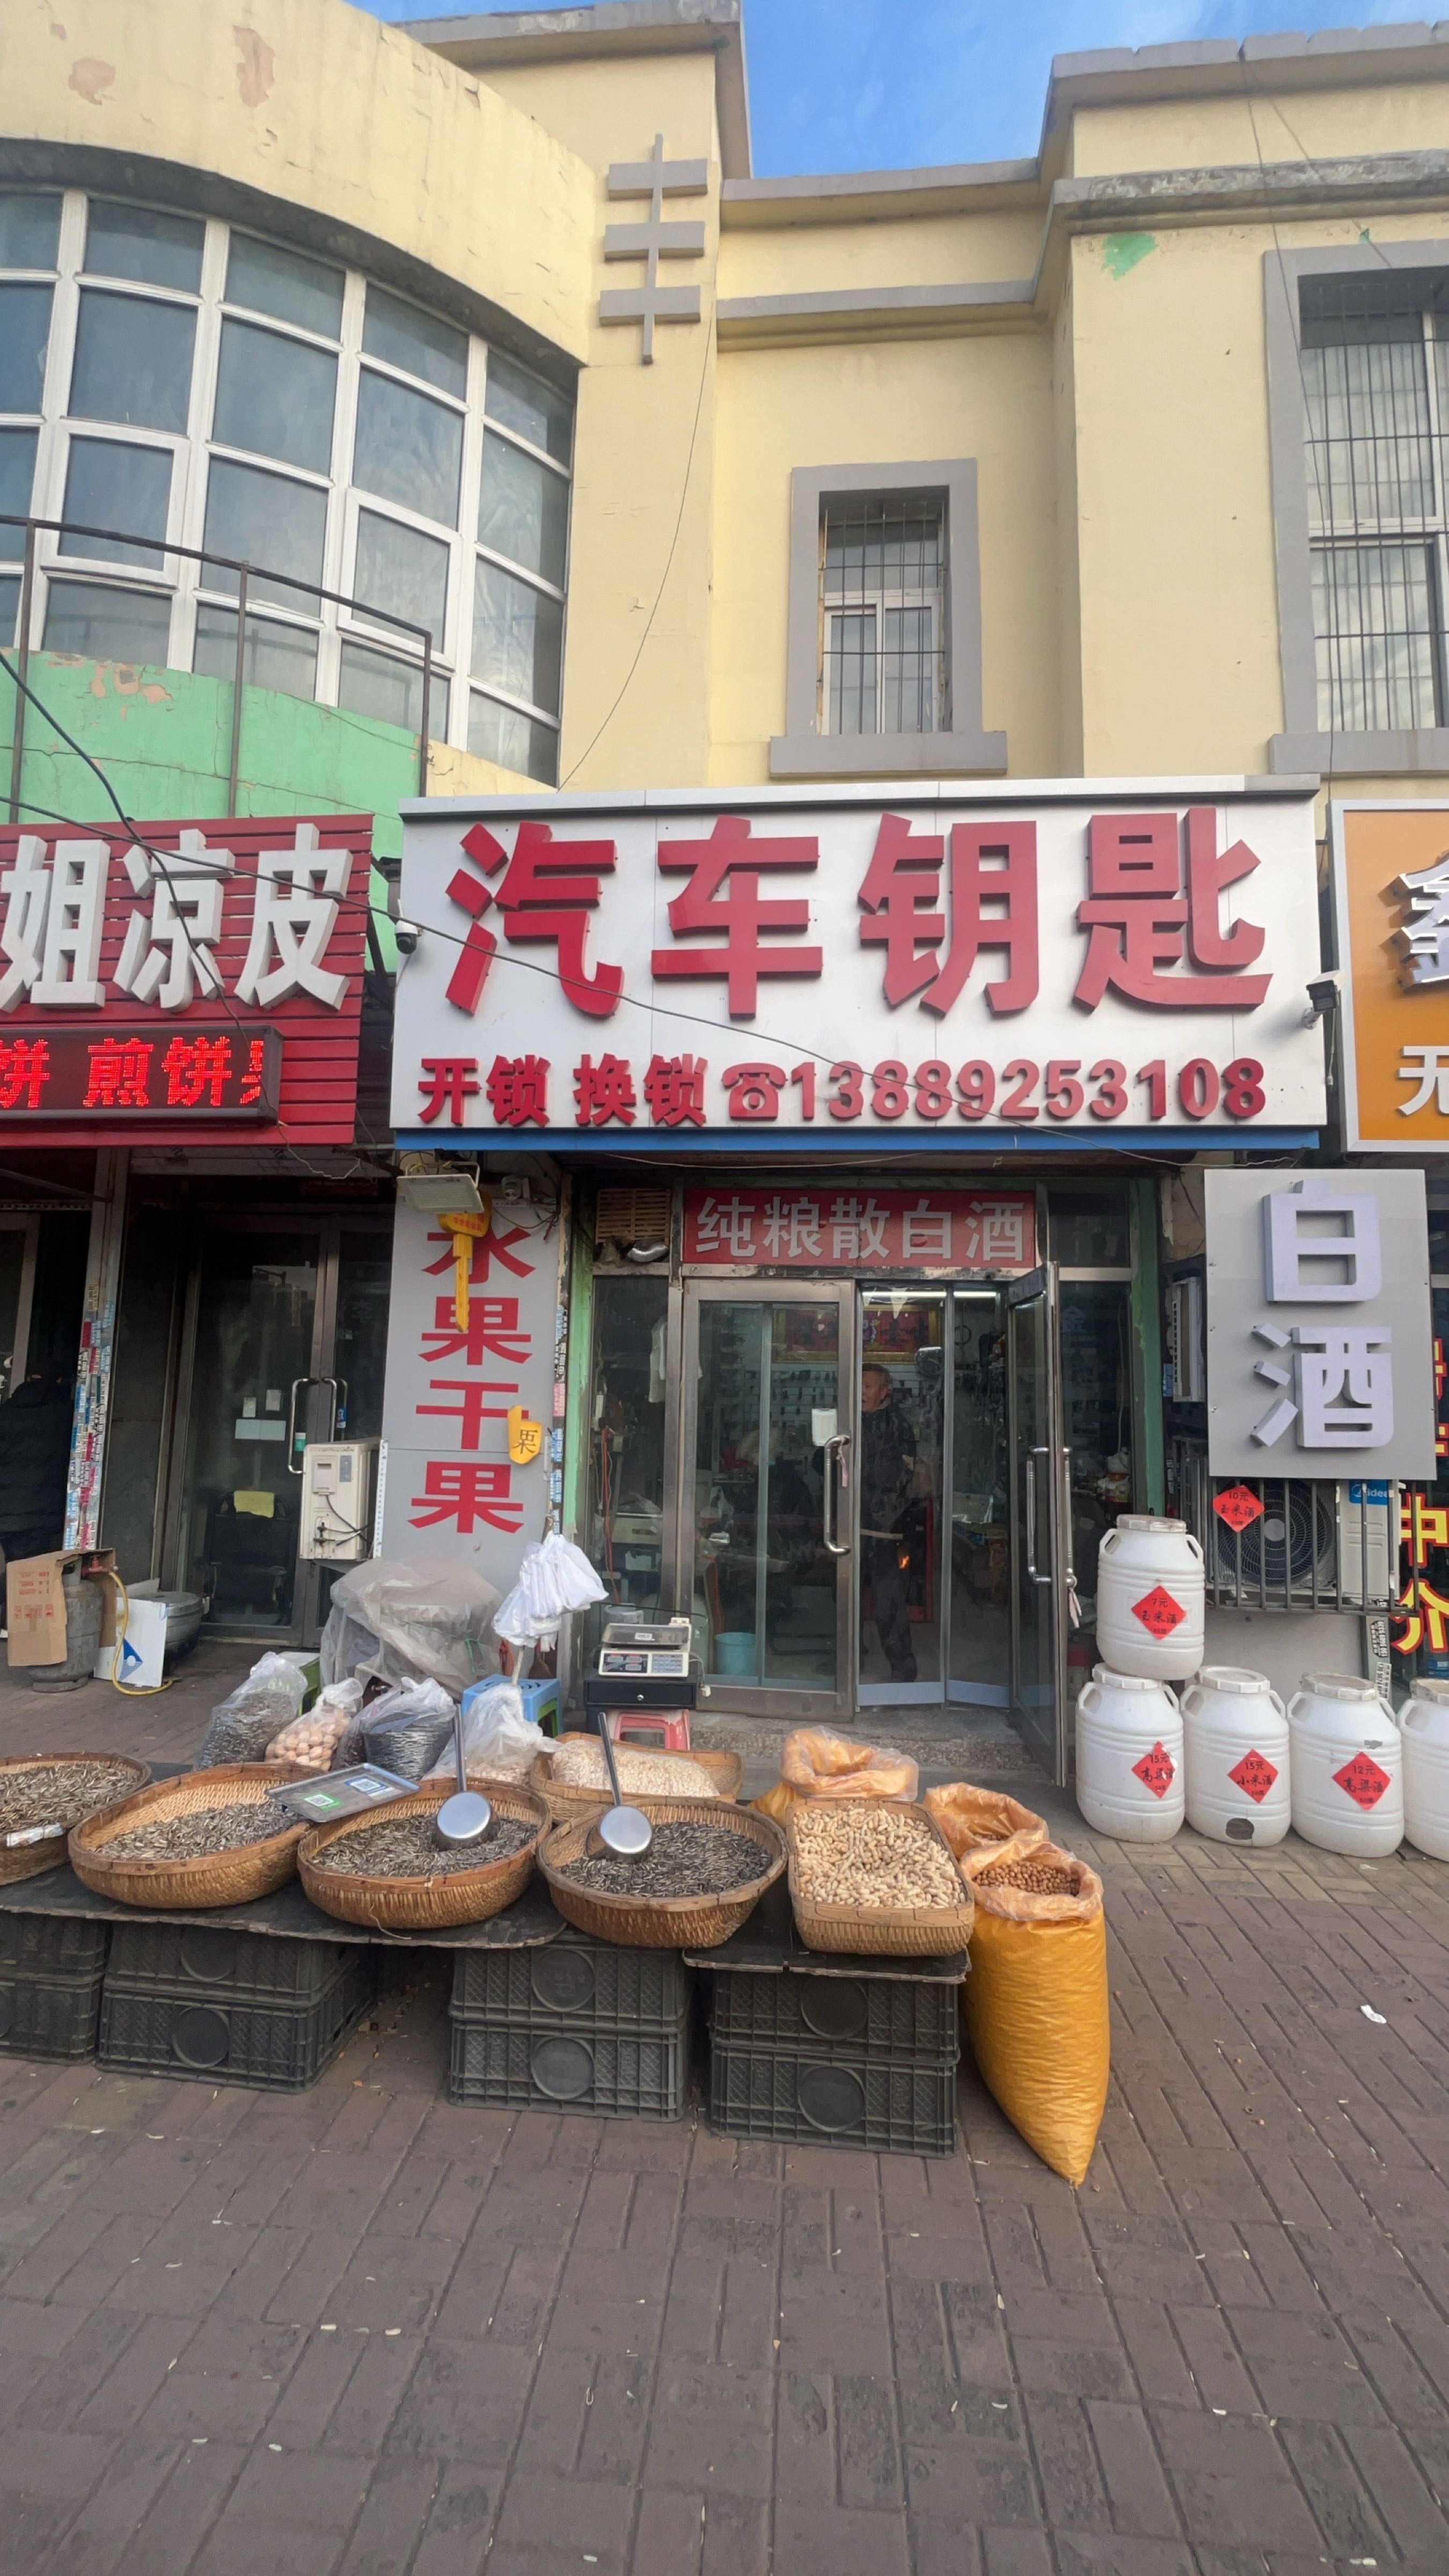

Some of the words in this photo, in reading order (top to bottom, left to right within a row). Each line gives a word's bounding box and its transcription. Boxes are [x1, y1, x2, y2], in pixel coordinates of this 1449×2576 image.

[0, 823, 354, 1013] 姐凉皮
[445, 807, 1274, 1021] 汽车钥匙
[418, 1055, 551, 1128] 开锁
[573, 1053, 708, 1128] 换锁
[791, 1058, 1266, 1121] 13889253108
[696, 1196, 1024, 1261] 纯粮散白酒
[1250, 1180, 1394, 1448] 白酒
[407, 1225, 536, 1534] 水果干果
